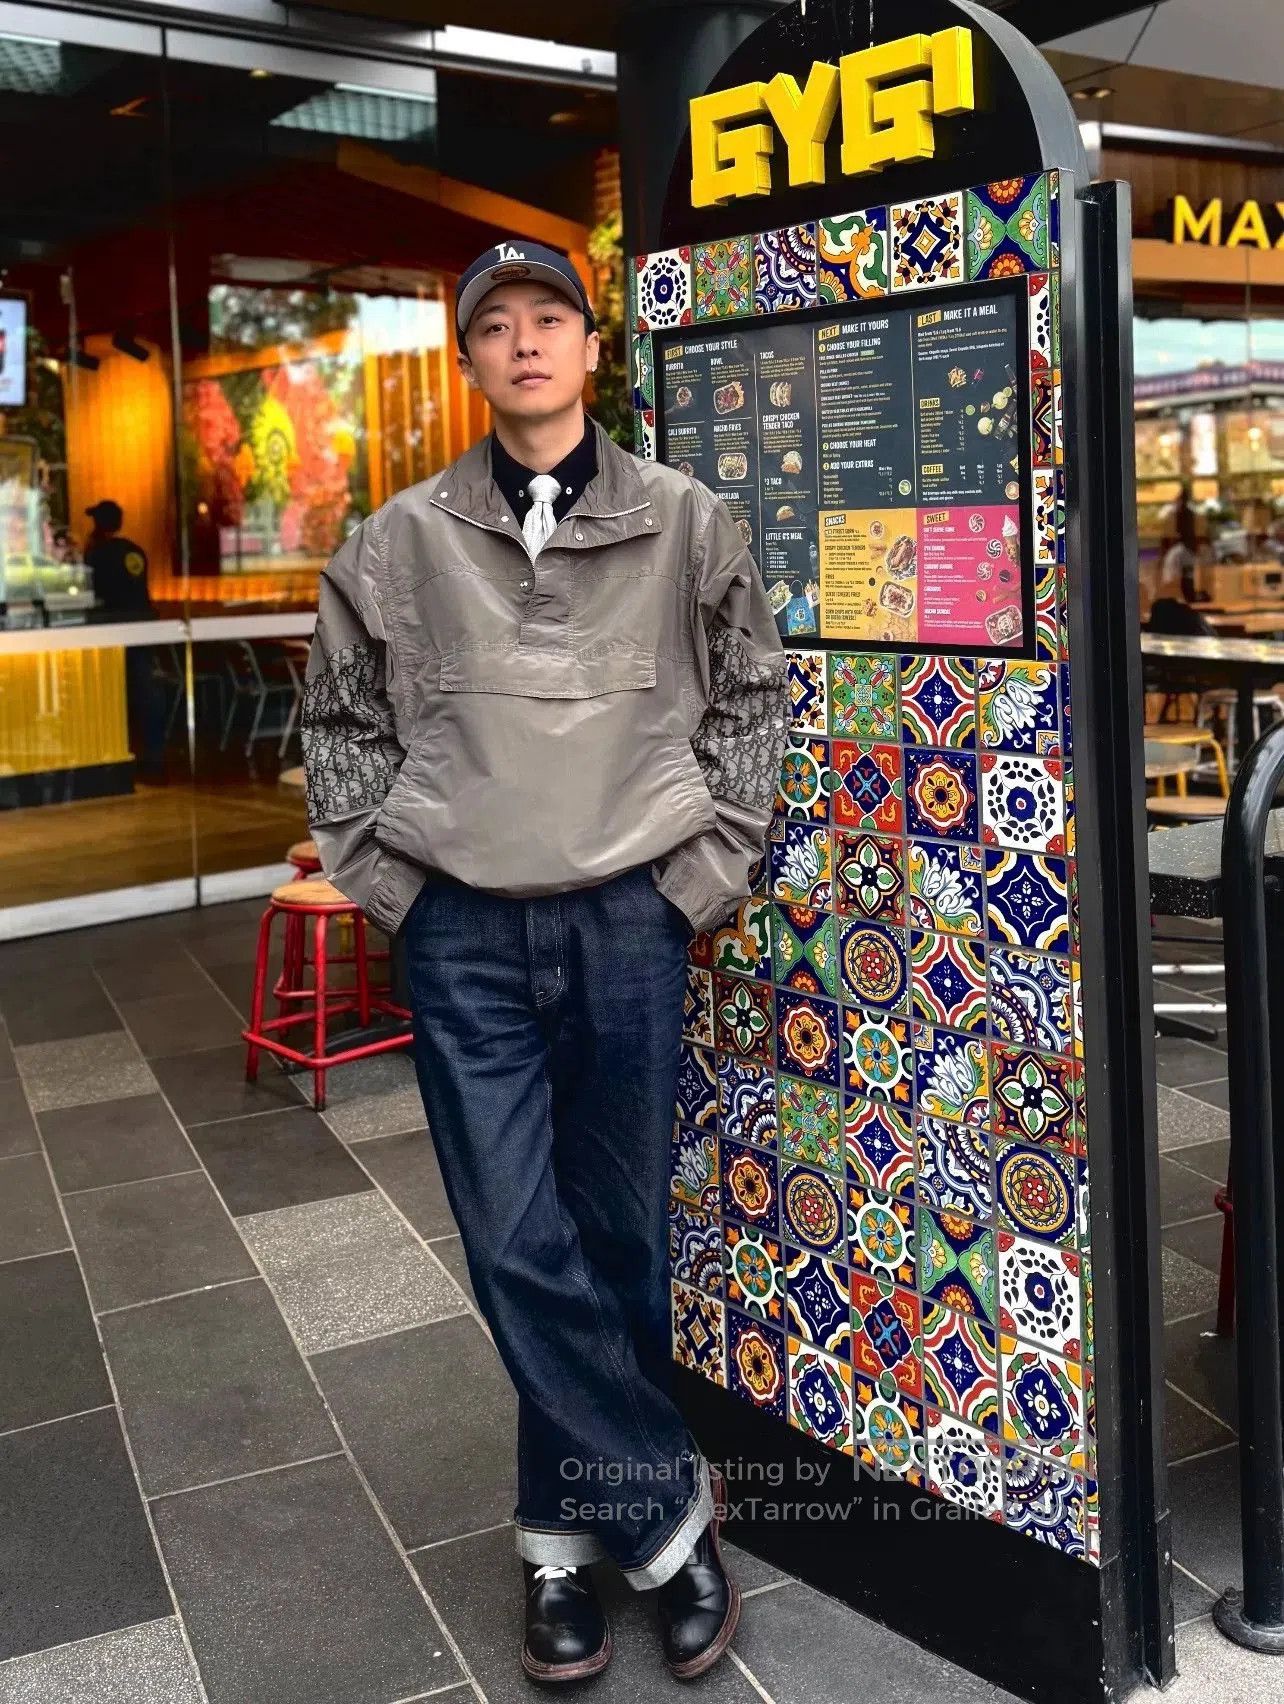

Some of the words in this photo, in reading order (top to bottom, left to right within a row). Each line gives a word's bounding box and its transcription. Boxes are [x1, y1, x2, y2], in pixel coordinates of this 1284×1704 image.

[1173, 195, 1284, 250] MA
[921, 312, 937, 325] LAST
[943, 309, 963, 321] MAKE
[964, 307, 972, 318] IT
[972, 306, 978, 317] A
[979, 304, 998, 316] MEAL
[821, 326, 837, 339] NEXT
[842, 324, 859, 334] MAKE
[860, 322, 867, 332] IT
[867, 319, 889, 330] YOURS
[684, 344, 705, 355] CHOOSE
[705, 341, 720, 352] YOUR
[720, 339, 738, 350] STYLE
[826, 341, 846, 351] CHOOSE
[846, 340, 860, 349] YOUR
[861, 337, 881, 347] FILLING
[920, 398, 939, 408] DRINKS
[762, 414, 779, 422] CRISPY
[780, 412, 800, 421] CHICKEN
[763, 421, 781, 430] TENDER
[829, 441, 849, 450] CHOOSE
[849, 440, 863, 449] YOUR
[863, 438, 877, 447] HEAT
[841, 460, 855, 469] YOUR
[855, 459, 874, 468] EXTRAS
[923, 466, 942, 474] COFFEE
[825, 515, 845, 526] SNACKS
[926, 512, 946, 524] SWEET
[765, 532, 782, 541] LITTLE
[790, 532, 804, 540] MEAL
